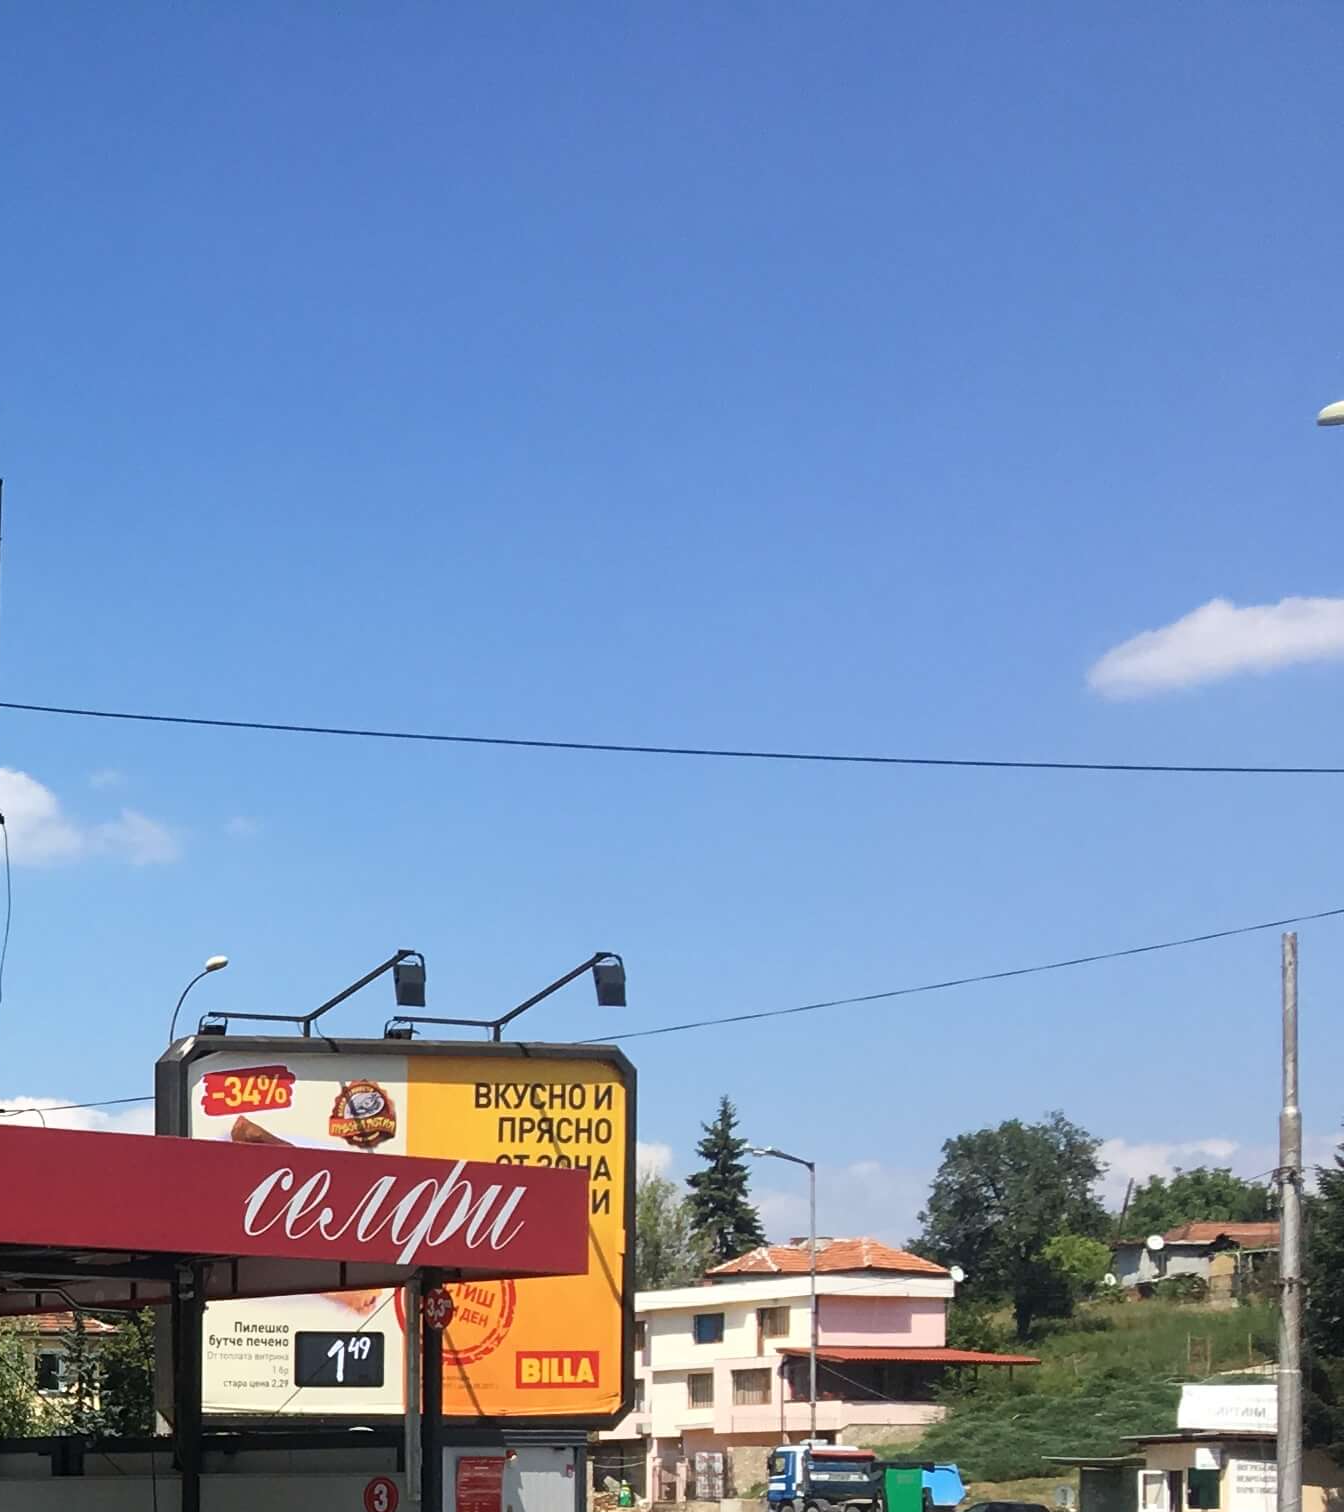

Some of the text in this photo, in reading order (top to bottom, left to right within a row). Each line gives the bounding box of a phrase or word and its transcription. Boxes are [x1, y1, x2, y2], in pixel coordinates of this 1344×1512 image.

[212, 1073, 288, 1107] -34%
[474, 1083, 613, 1110] ВКУСНО И
[498, 1117, 612, 1144] ПРЯСНО
[244, 1160, 527, 1264] селфи
[234, 1321, 290, 1333] Пилешко
[209, 1334, 290, 1349] бутче печено
[521, 1357, 596, 1384] BILLA
[374, 1484, 389, 1512] 3
